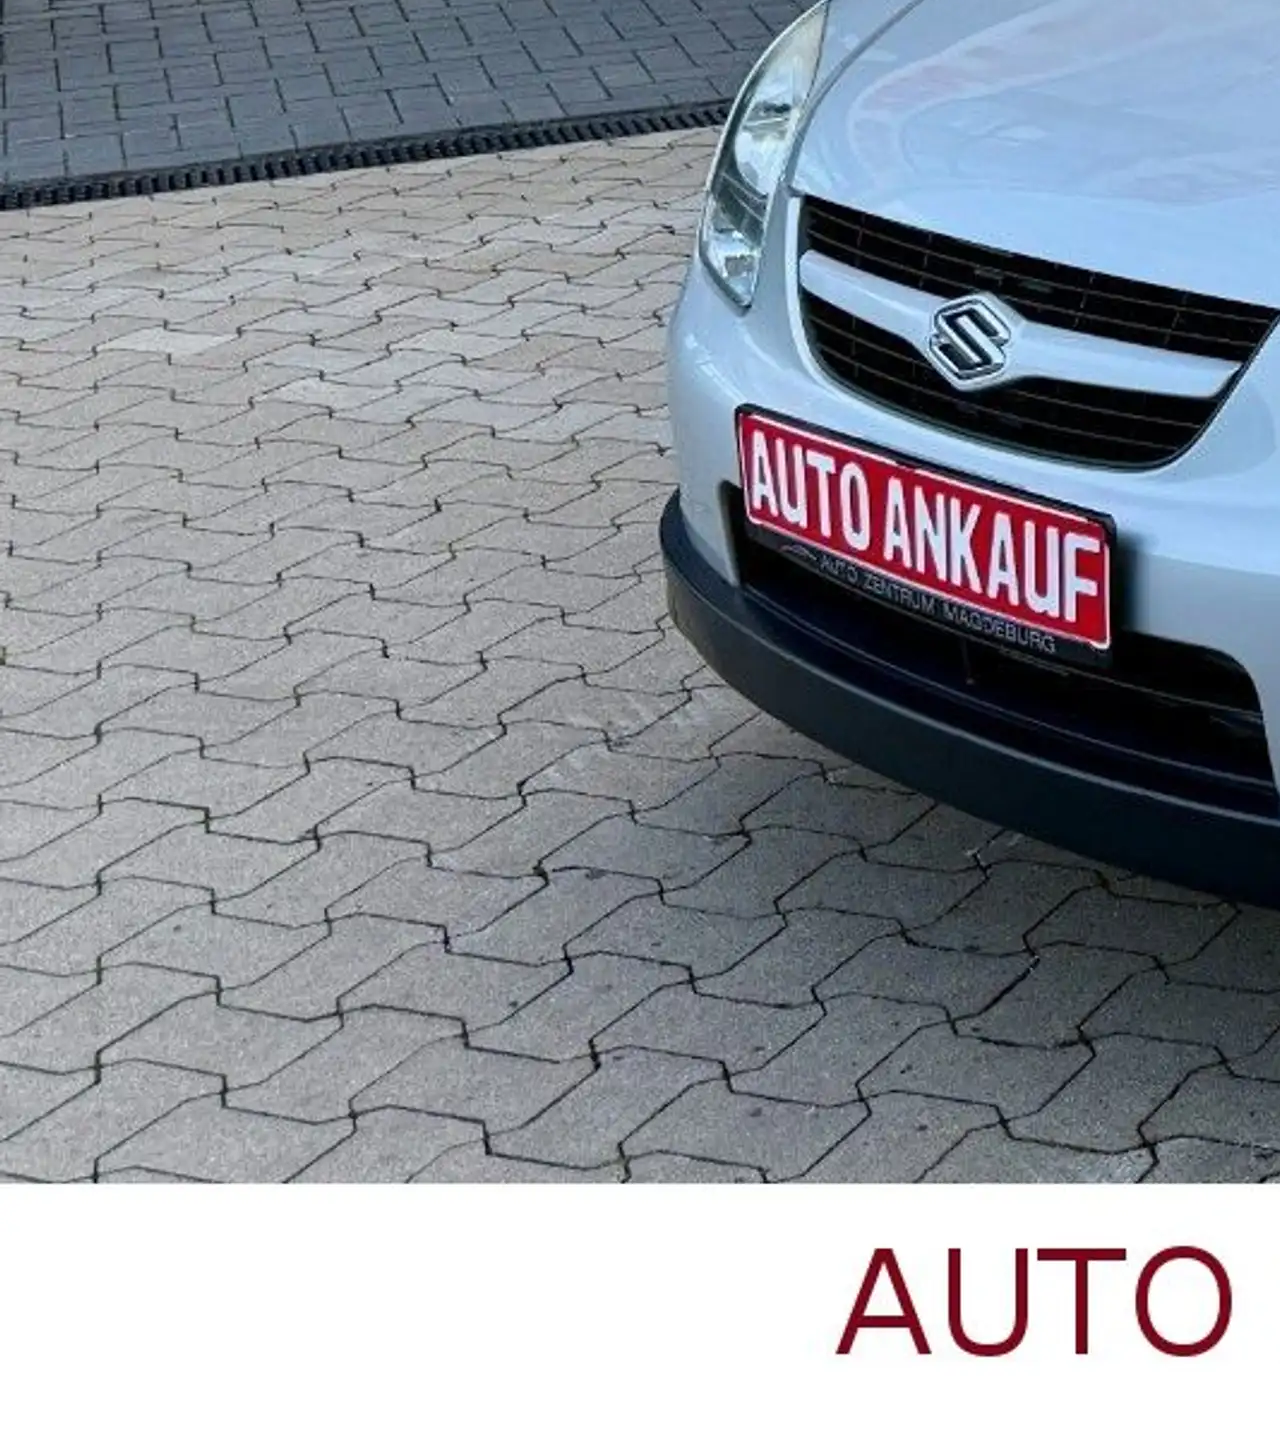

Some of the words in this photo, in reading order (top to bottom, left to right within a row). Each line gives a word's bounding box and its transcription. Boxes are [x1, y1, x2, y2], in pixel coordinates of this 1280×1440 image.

[750, 428, 870, 552] AUTO
[883, 478, 1101, 623] ANKAUF
[819, 553, 860, 582] AUTO
[863, 571, 936, 613] ZENTRUM
[943, 601, 1056, 654] MAGDEBURG
